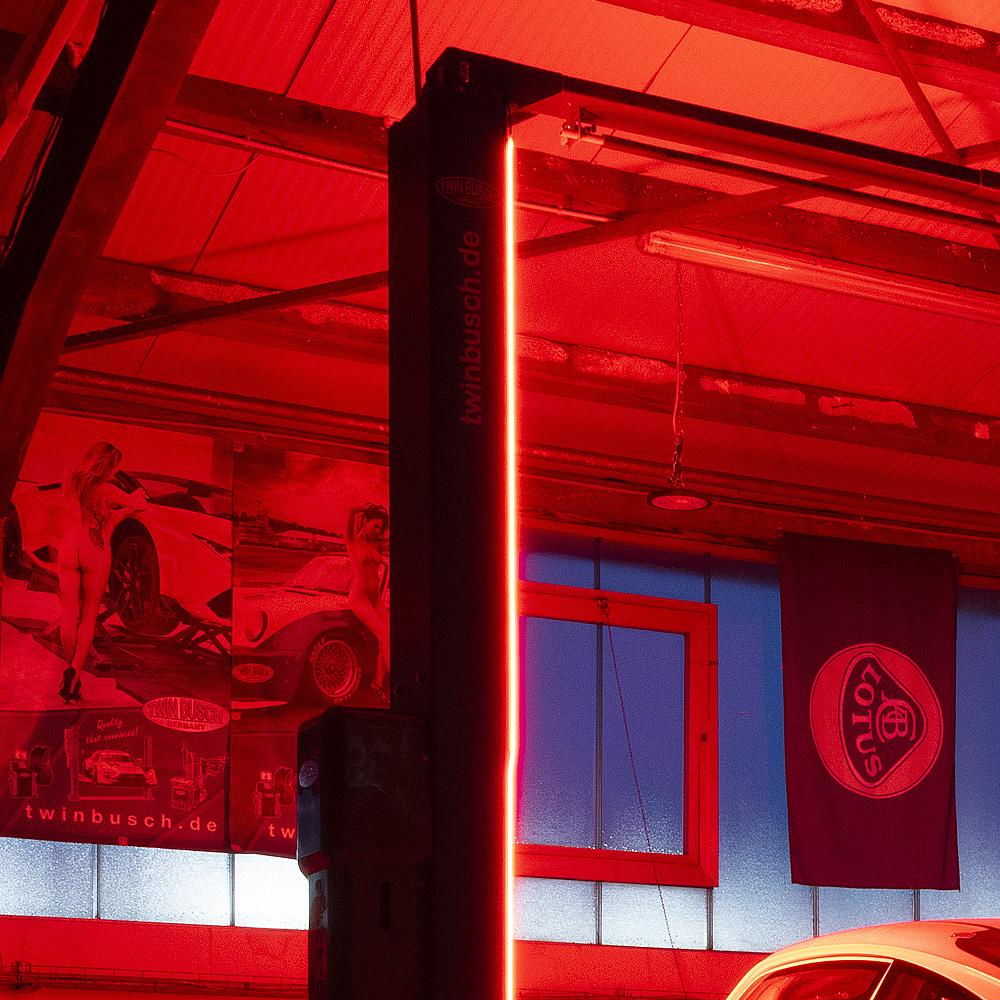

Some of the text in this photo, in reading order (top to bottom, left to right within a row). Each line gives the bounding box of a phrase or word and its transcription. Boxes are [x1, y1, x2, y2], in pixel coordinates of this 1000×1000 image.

[440, 180, 463, 194] TWIN
[457, 230, 482, 425] twinbusch.de
[147, 699, 223, 722] TWIN BUSCH
[96, 717, 123, 731] Quality
[166, 720, 206, 731] GERMANY
[852, 663, 882, 777] LOTUS
[86, 735, 102, 744] that
[25, 804, 218, 832] twinbusch.de
